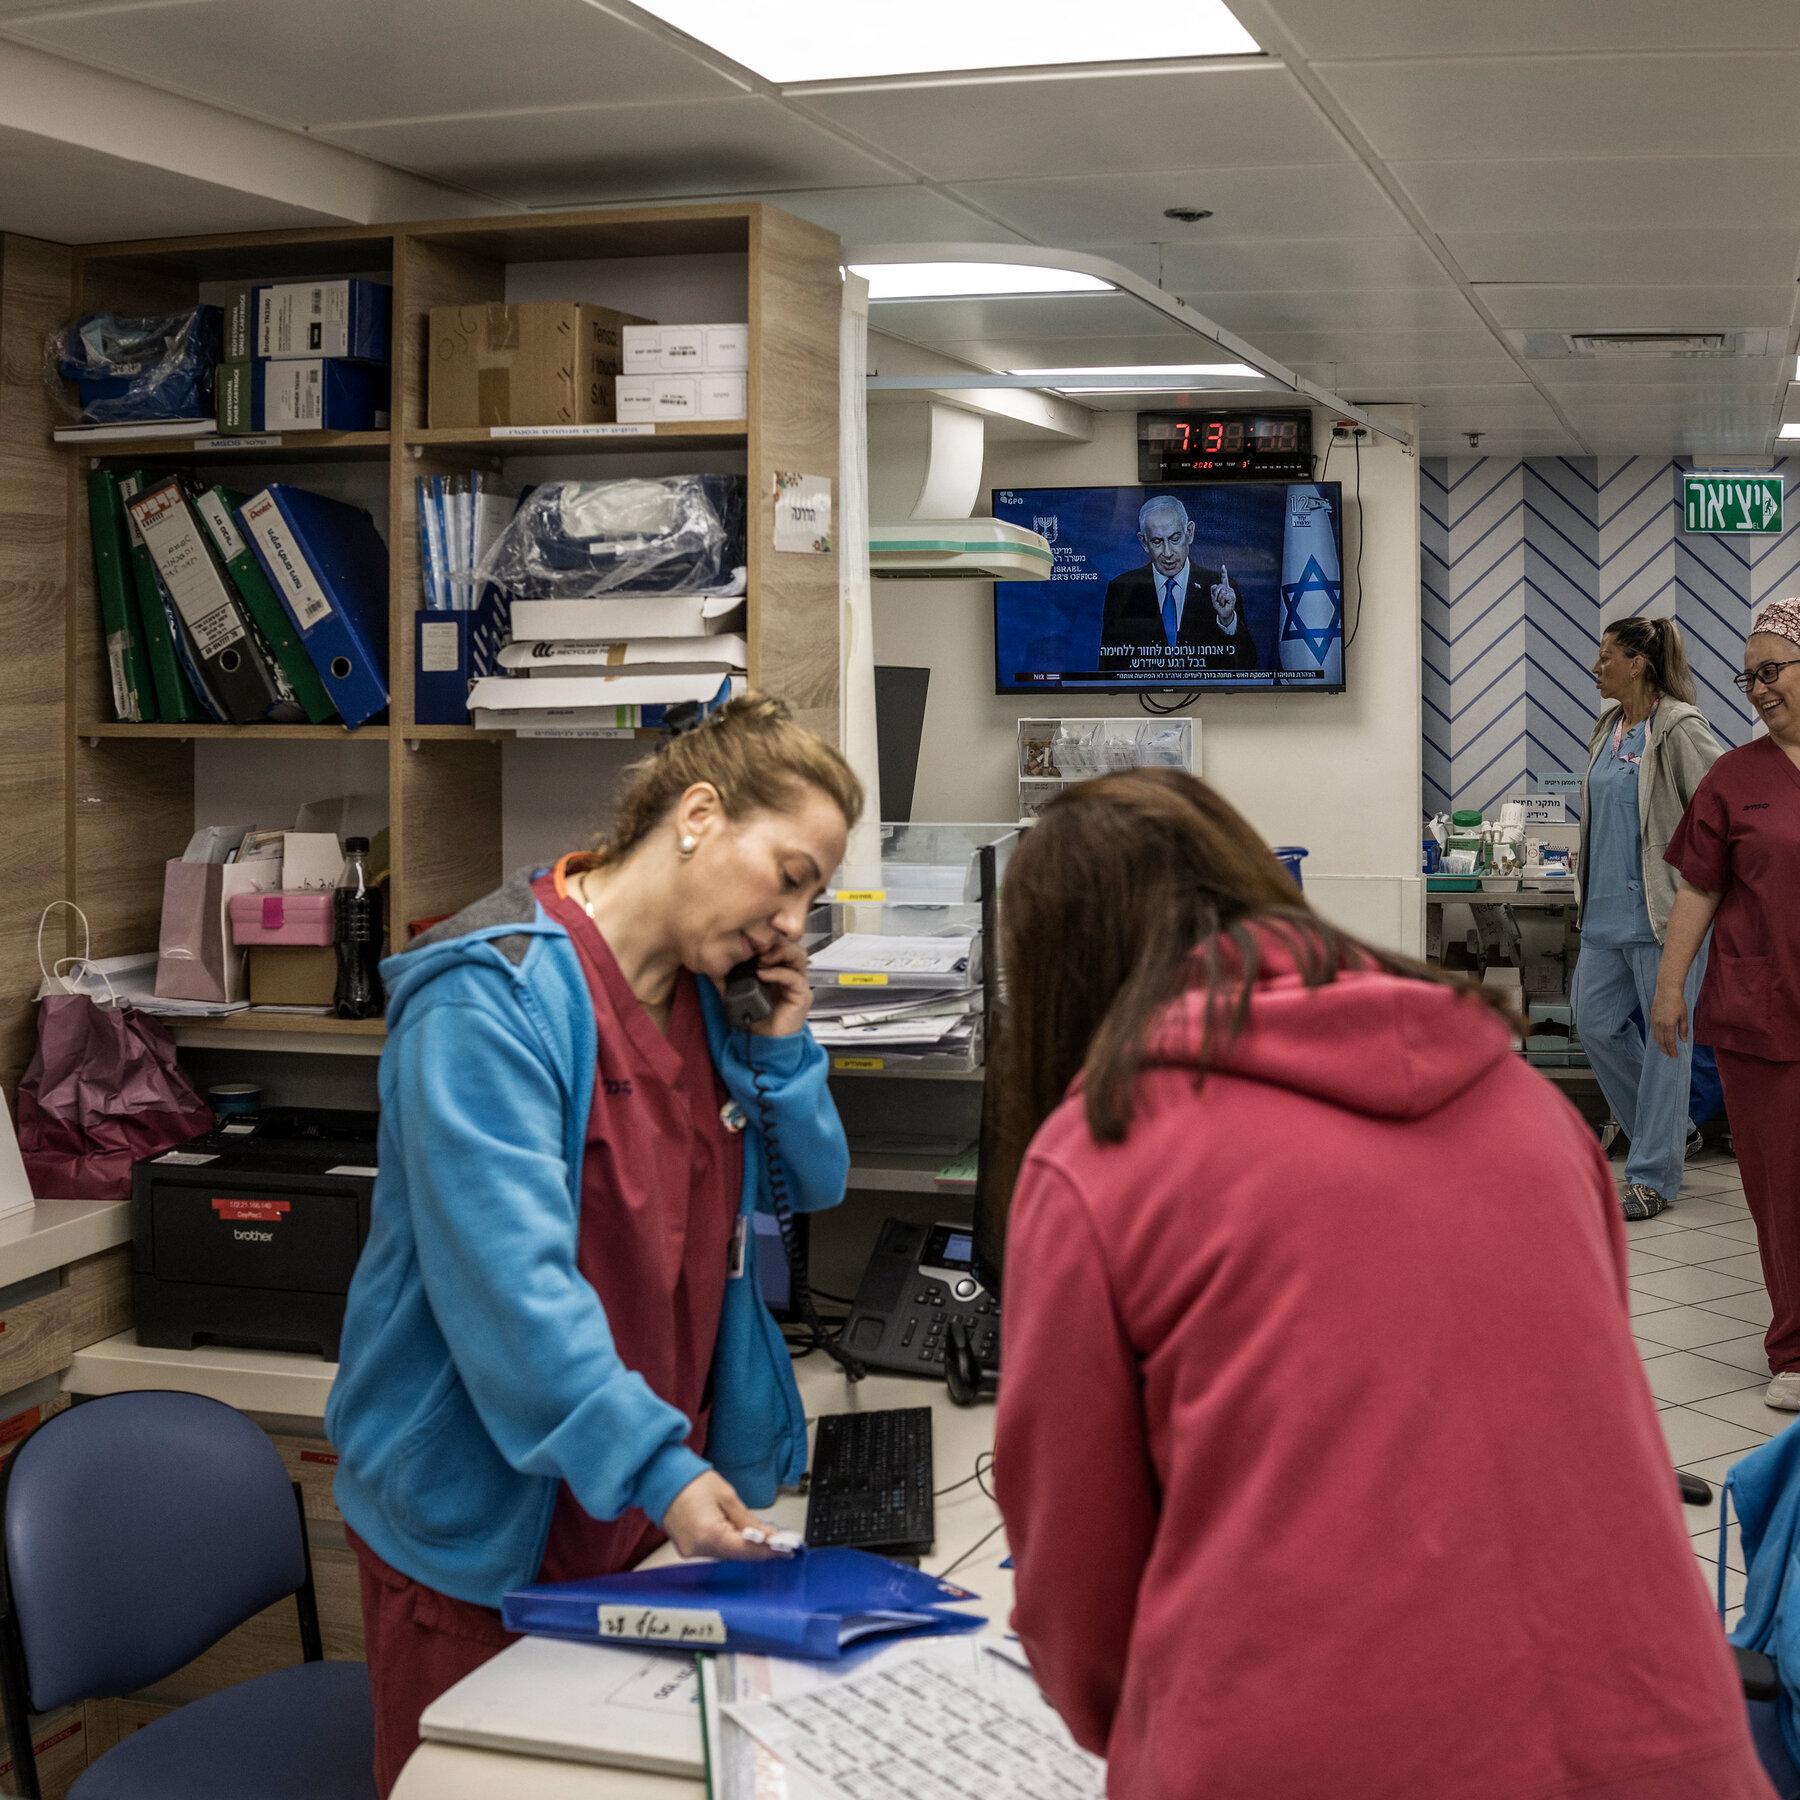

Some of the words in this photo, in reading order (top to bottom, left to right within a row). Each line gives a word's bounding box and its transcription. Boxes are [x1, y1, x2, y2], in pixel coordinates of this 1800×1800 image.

[238, 294, 246, 332] CARTRIDGE
[231, 306, 239, 357] PROFESSIONAL
[232, 368, 240, 404] CARTRIDGE
[1193, 461, 1213, 469] 2026
[1008, 497, 1024, 505] GPO
[1689, 483, 1761, 529] יציאה
[791, 507, 816, 522] הדרכה
[1070, 572, 1098, 580] OFFICE
[1100, 645, 1135, 656] ללחימה
[1137, 645, 1161, 655] לחזור
[1164, 646, 1196, 656] ערוכים
[1197, 646, 1223, 655] אנחנו
[1225, 646, 1236, 655] כי
[1167, 658, 1185, 668] רגע
[1187, 657, 1206, 668] בכל
[1535, 799, 1560, 808] מתקני
[233, 1229, 273, 1242] brother
